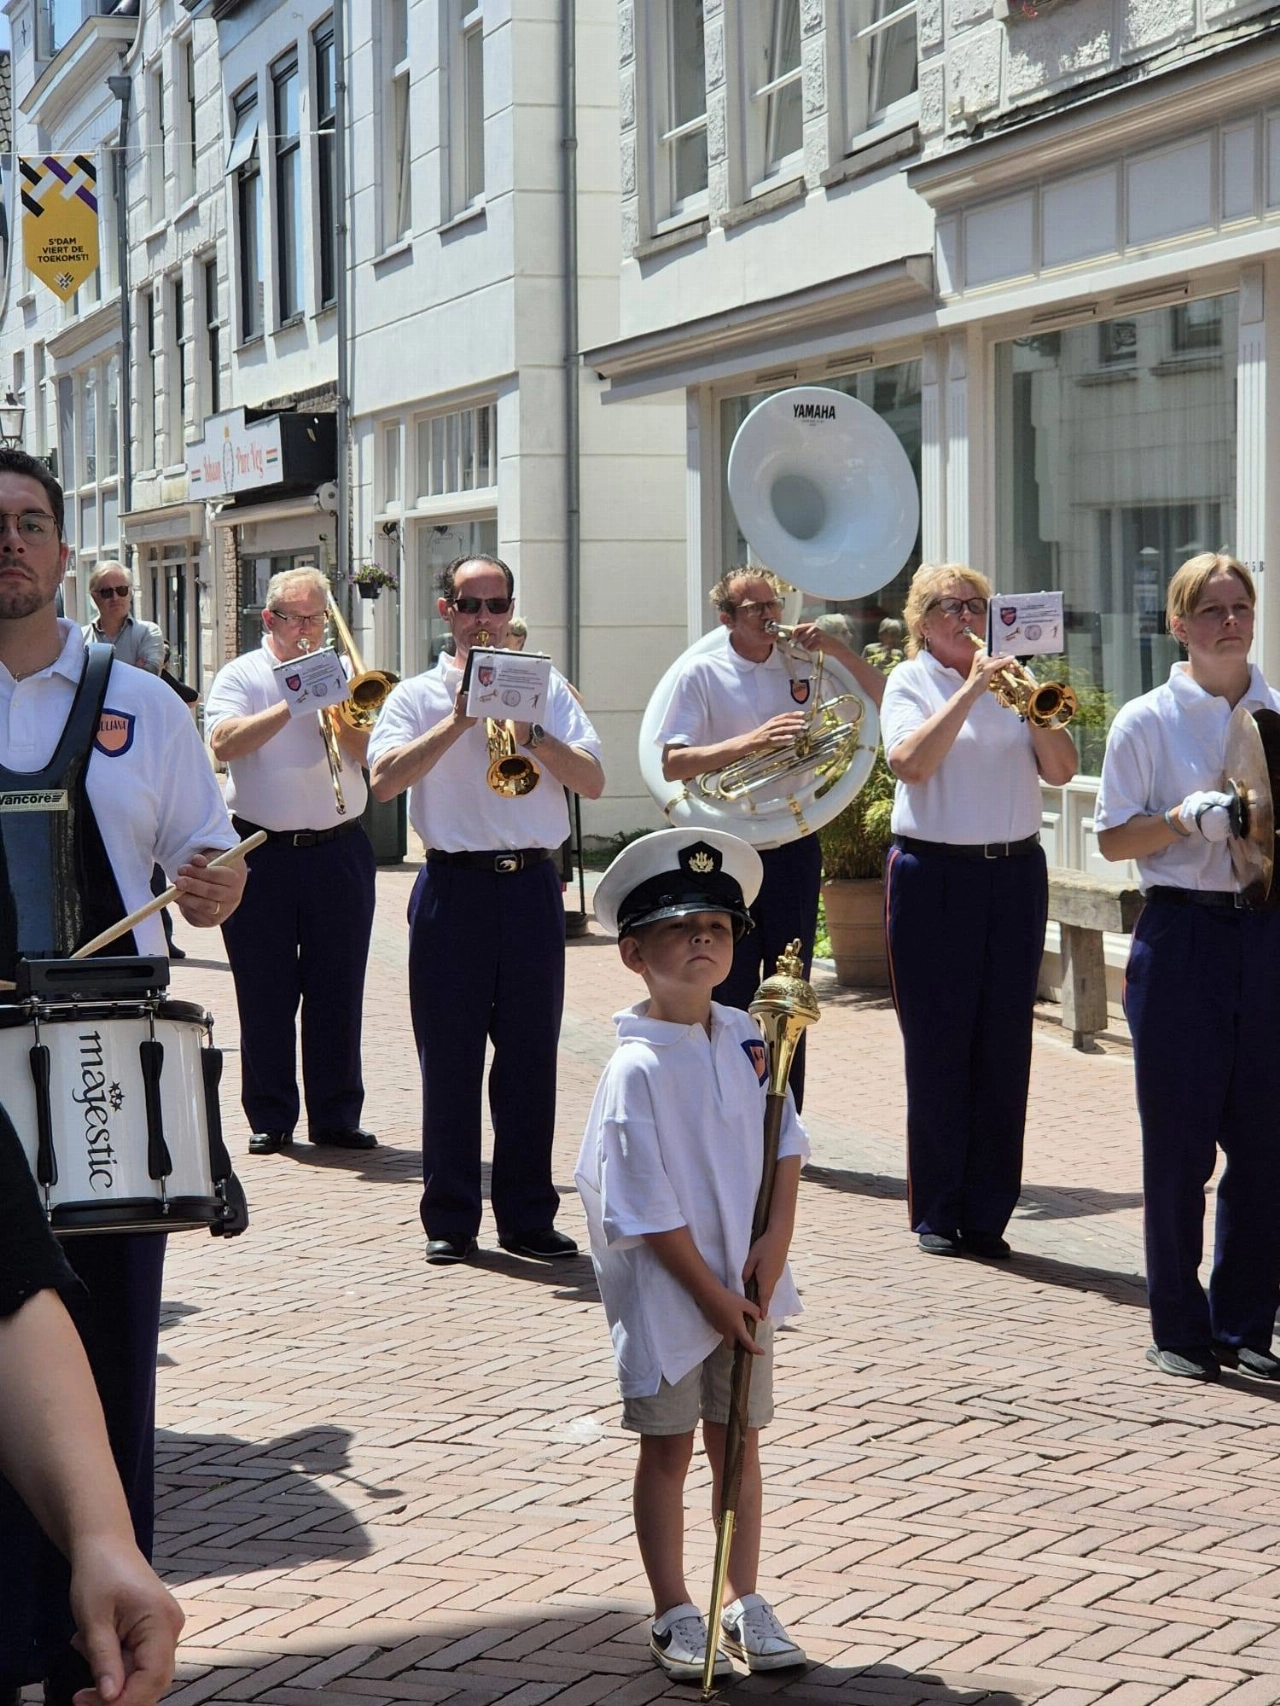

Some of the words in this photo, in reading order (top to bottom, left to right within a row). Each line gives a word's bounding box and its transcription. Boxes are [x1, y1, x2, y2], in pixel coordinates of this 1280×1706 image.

[48, 237, 77, 246] S'DAM
[42, 246, 69, 254] VIERT
[71, 245, 84, 253] DE
[37, 253, 89, 263] TOEKOMST!
[793, 403, 836, 420] YAMAHA
[71, 1030, 118, 1193] majestic
